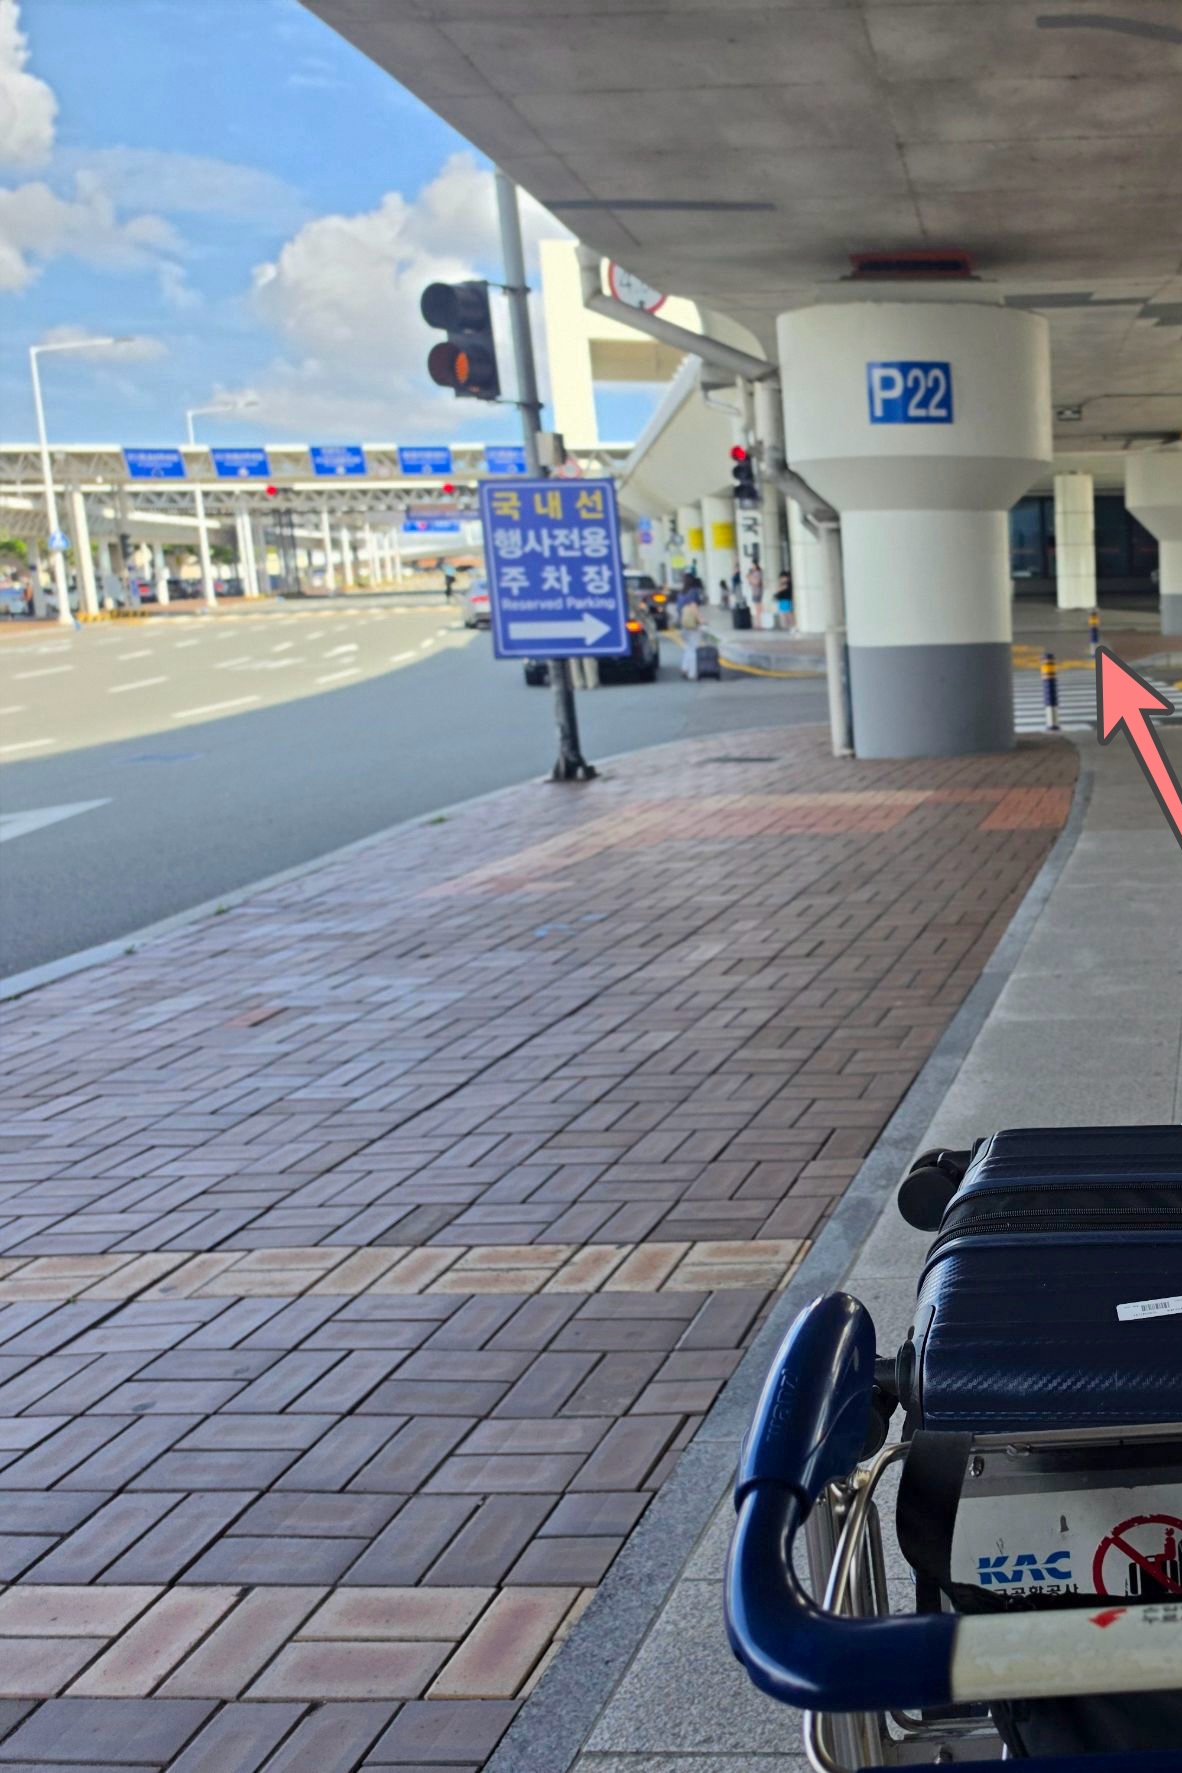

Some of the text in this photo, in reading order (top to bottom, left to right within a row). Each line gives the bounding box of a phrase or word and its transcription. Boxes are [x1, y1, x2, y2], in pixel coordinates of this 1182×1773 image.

[494, 526, 609, 559] 행사전용
[501, 597, 616, 611] Reserved Parking
[977, 1551, 1072, 1585] KAC
